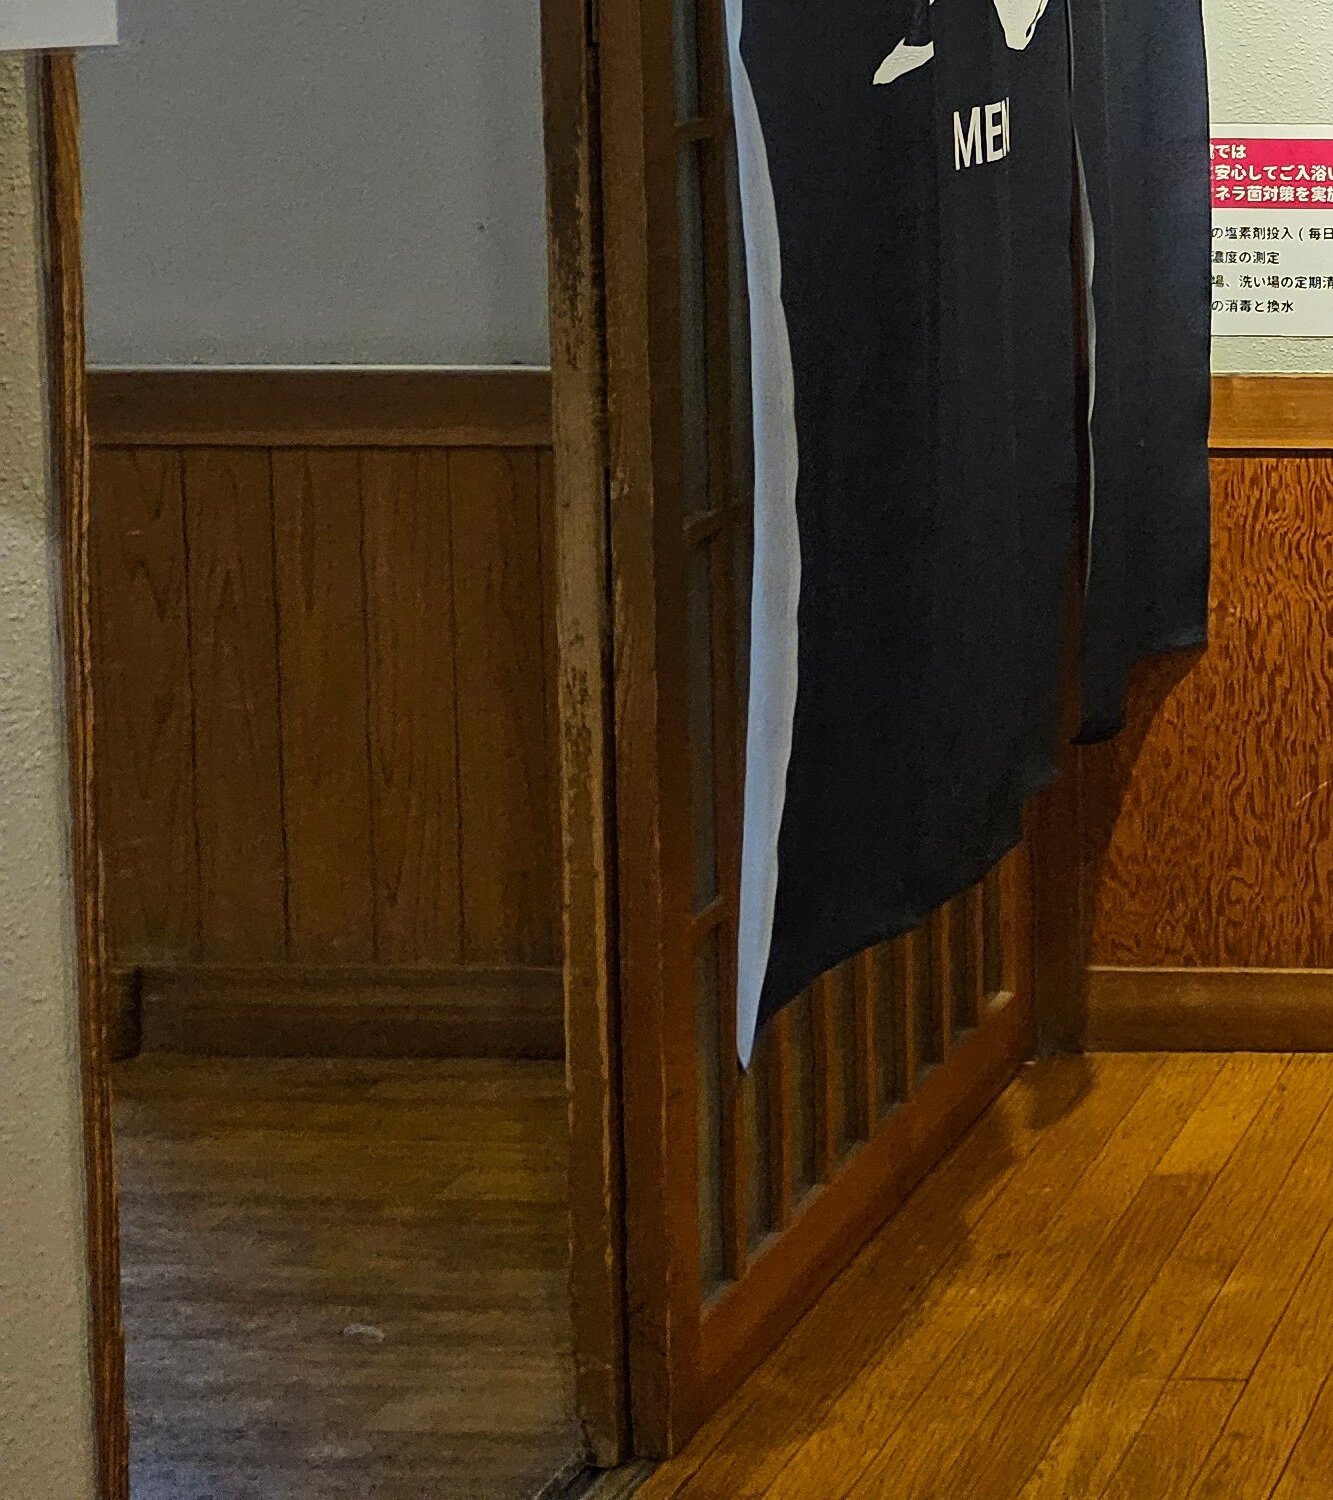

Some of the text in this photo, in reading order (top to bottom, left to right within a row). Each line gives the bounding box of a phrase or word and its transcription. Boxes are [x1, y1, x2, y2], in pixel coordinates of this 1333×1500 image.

[1212, 301, 1294, 313] の消毒と換水
